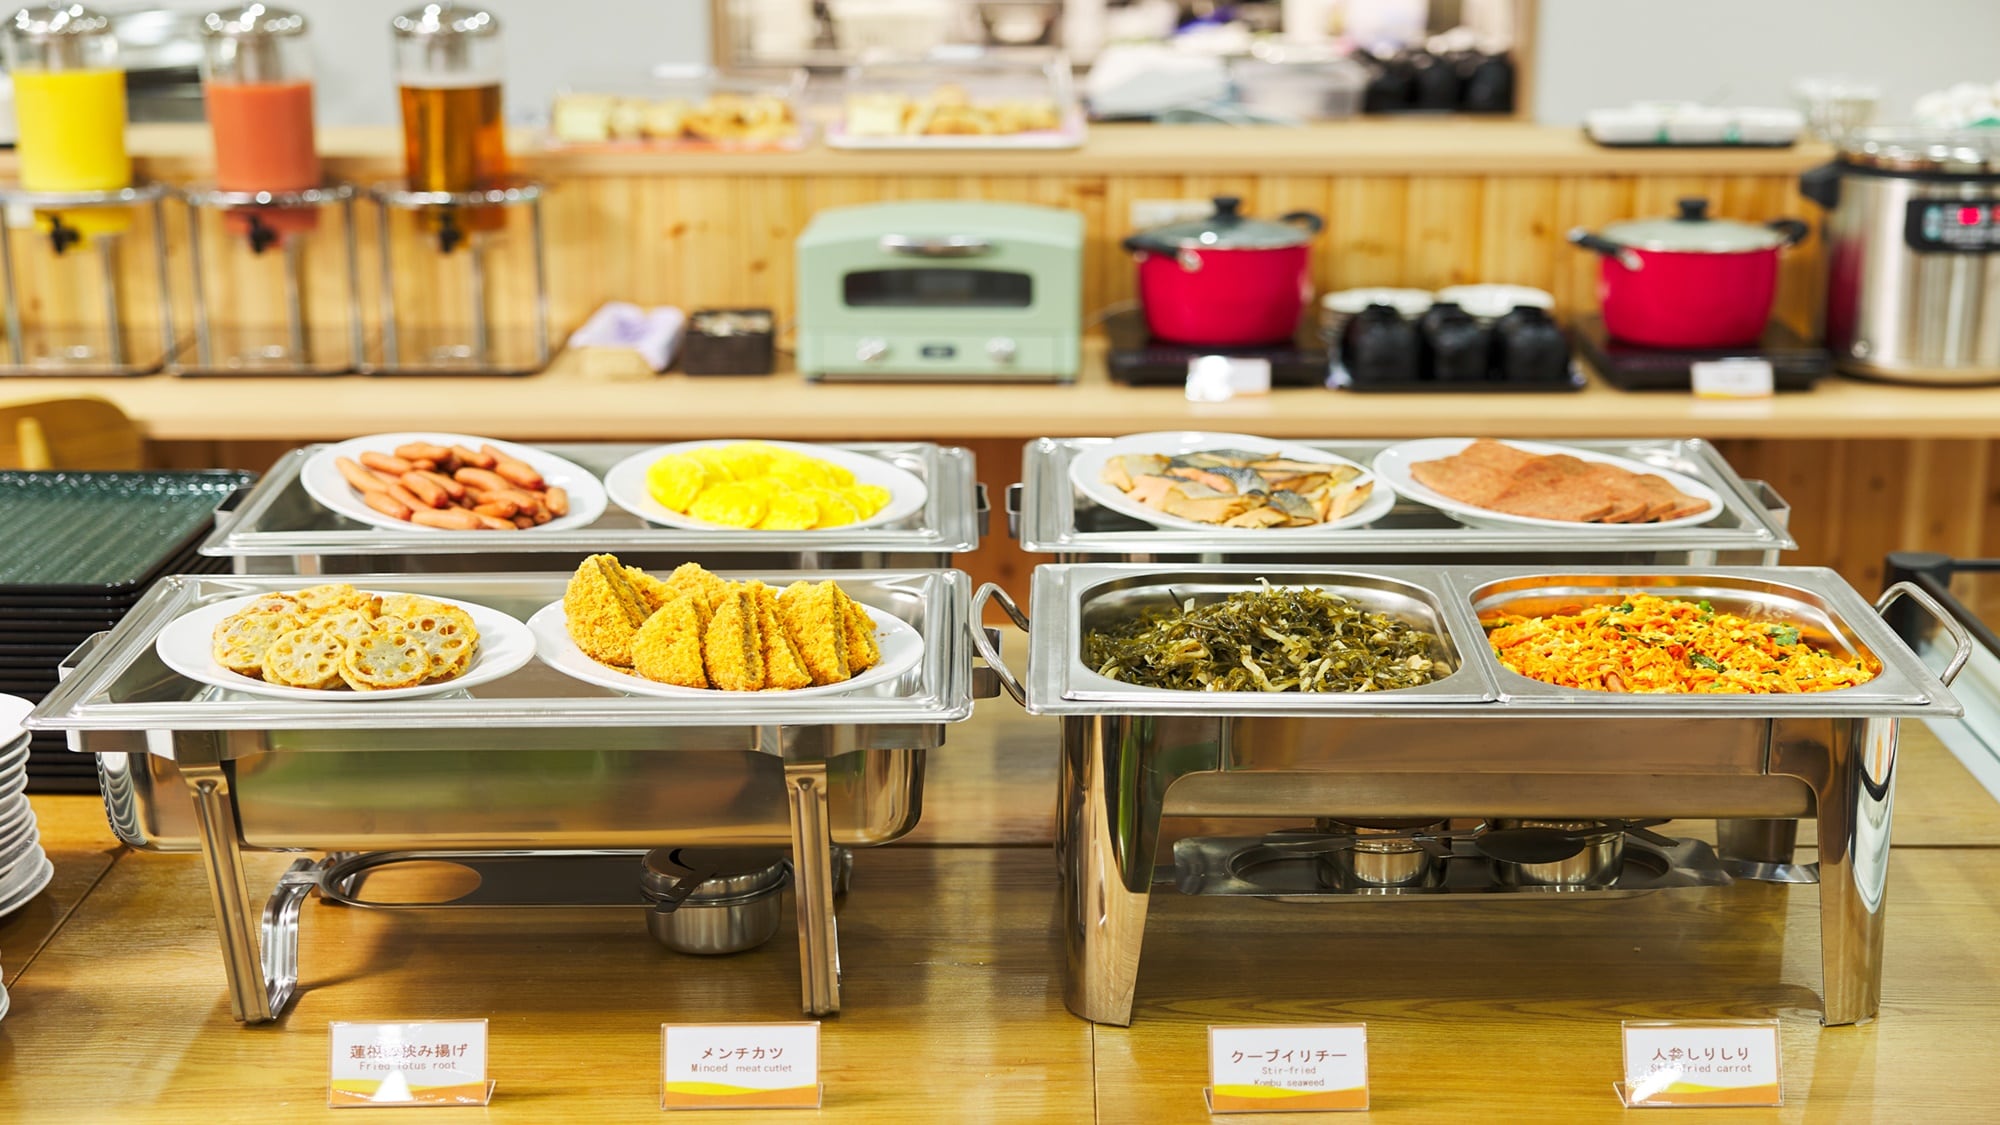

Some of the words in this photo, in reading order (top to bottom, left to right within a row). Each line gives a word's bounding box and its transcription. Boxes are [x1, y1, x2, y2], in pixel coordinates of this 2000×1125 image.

[350, 1044, 468, 1059] 蓮根挟み揚げ
[702, 1047, 783, 1059] メンチカツ
[1231, 1050, 1347, 1063] クーブイリチー
[1652, 1048, 1749, 1060] 人参しりしり
[432, 1061, 457, 1070] root
[691, 1064, 728, 1072] Minced
[736, 1064, 761, 1072] meat
[764, 1064, 792, 1072] cutlet
[1262, 1067, 1316, 1075] Stir-fried
